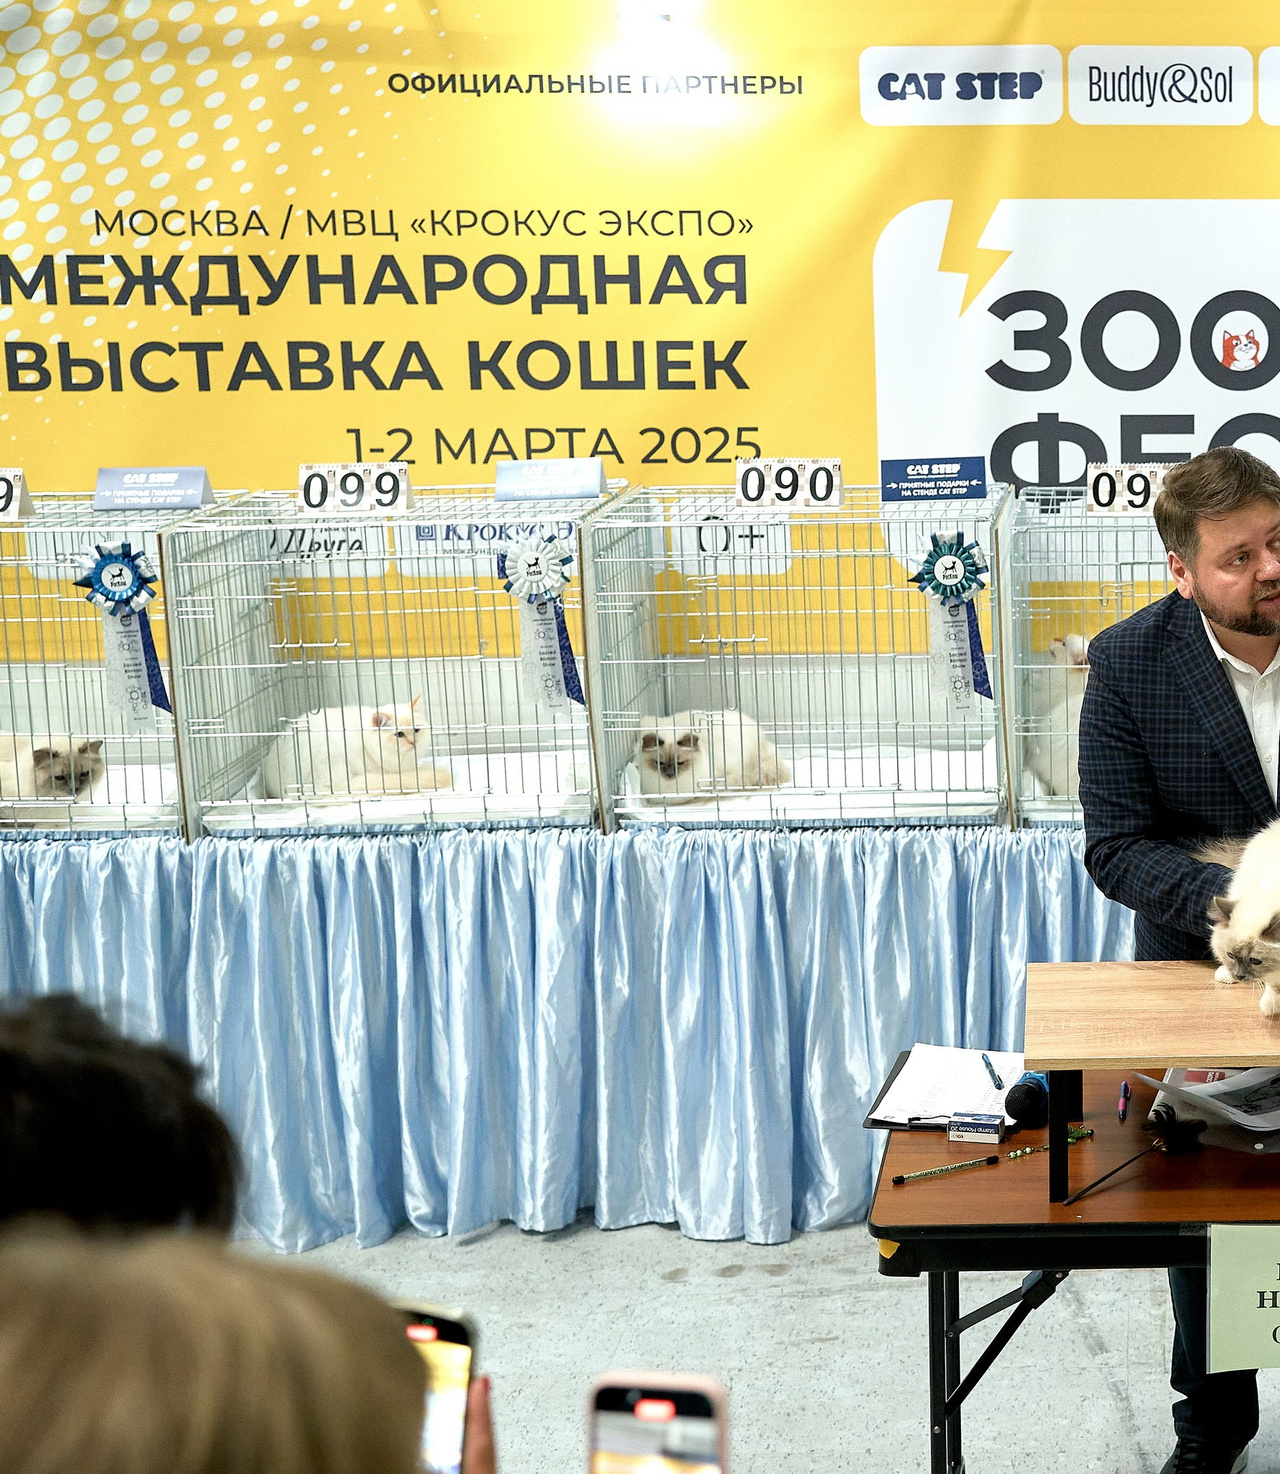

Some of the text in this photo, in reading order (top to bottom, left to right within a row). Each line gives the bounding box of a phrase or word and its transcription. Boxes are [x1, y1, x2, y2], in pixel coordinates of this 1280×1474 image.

[388, 72, 803, 97] ОФИЦИАЛЬНЫЕ ПАРТНЕРЫ
[877, 72, 1043, 100] CAT STEP
[1089, 63, 1233, 107] Buddy&Sol
[94, 204, 755, 242] МОСКВА / МВЦ «КРОКУС ЭКСПО»
[0, 253, 749, 316] МЕЖДУНАРОДНАЯ
[4, 340, 750, 393] ВЫСТАВКА КОШЕК
[346, 427, 762, 464] 1-2 МАРТА 2025
[741, 466, 835, 503] 090
[899, 480, 969, 489] ПРИЯТНЫЕ ПОДАРКИ
[906, 463, 961, 475] CAT STEP
[303, 471, 400, 509] 099
[1091, 472, 1151, 509] 09
